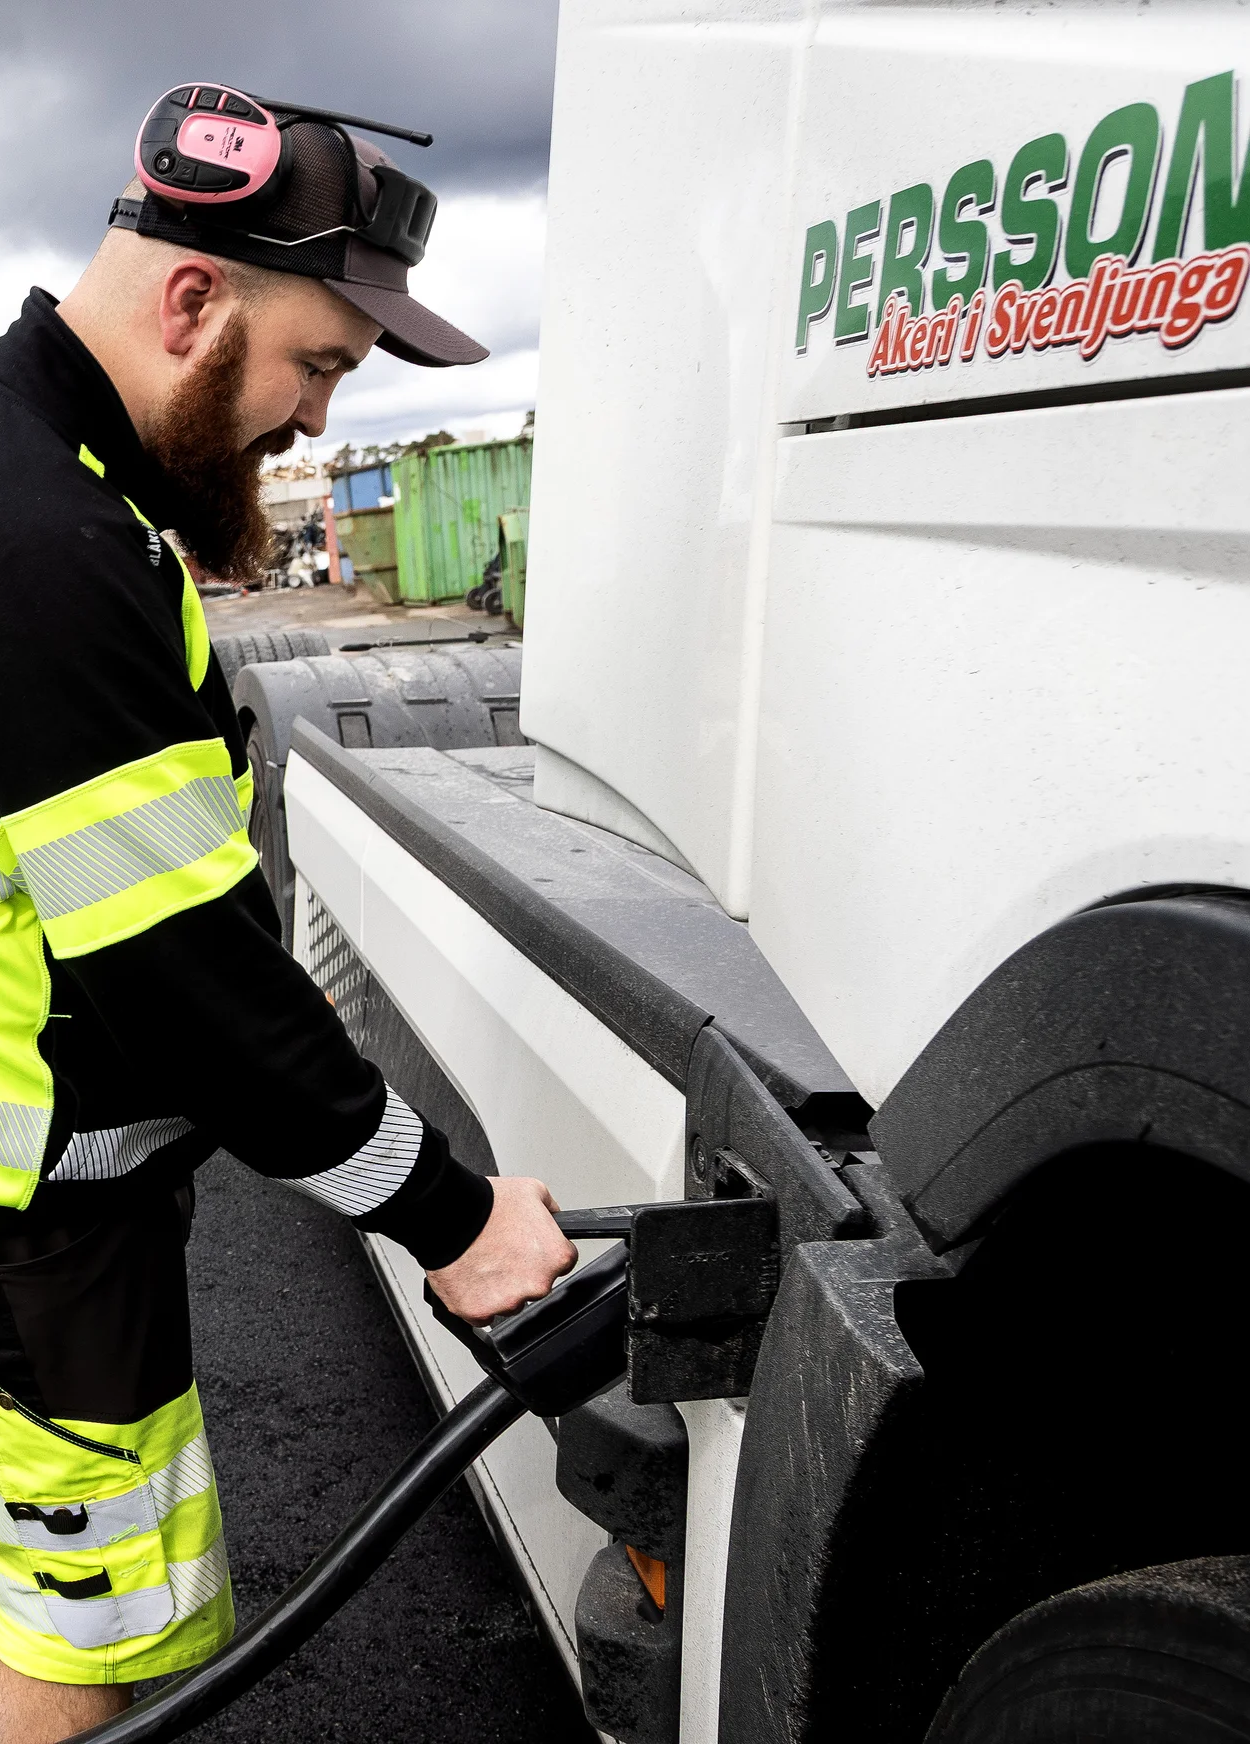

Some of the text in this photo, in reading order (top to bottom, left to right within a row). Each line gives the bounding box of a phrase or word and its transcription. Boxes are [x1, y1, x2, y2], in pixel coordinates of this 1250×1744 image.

[233, 136, 245, 152] 3M
[868, 250, 1248, 377] Åkeri i Svenljunga
